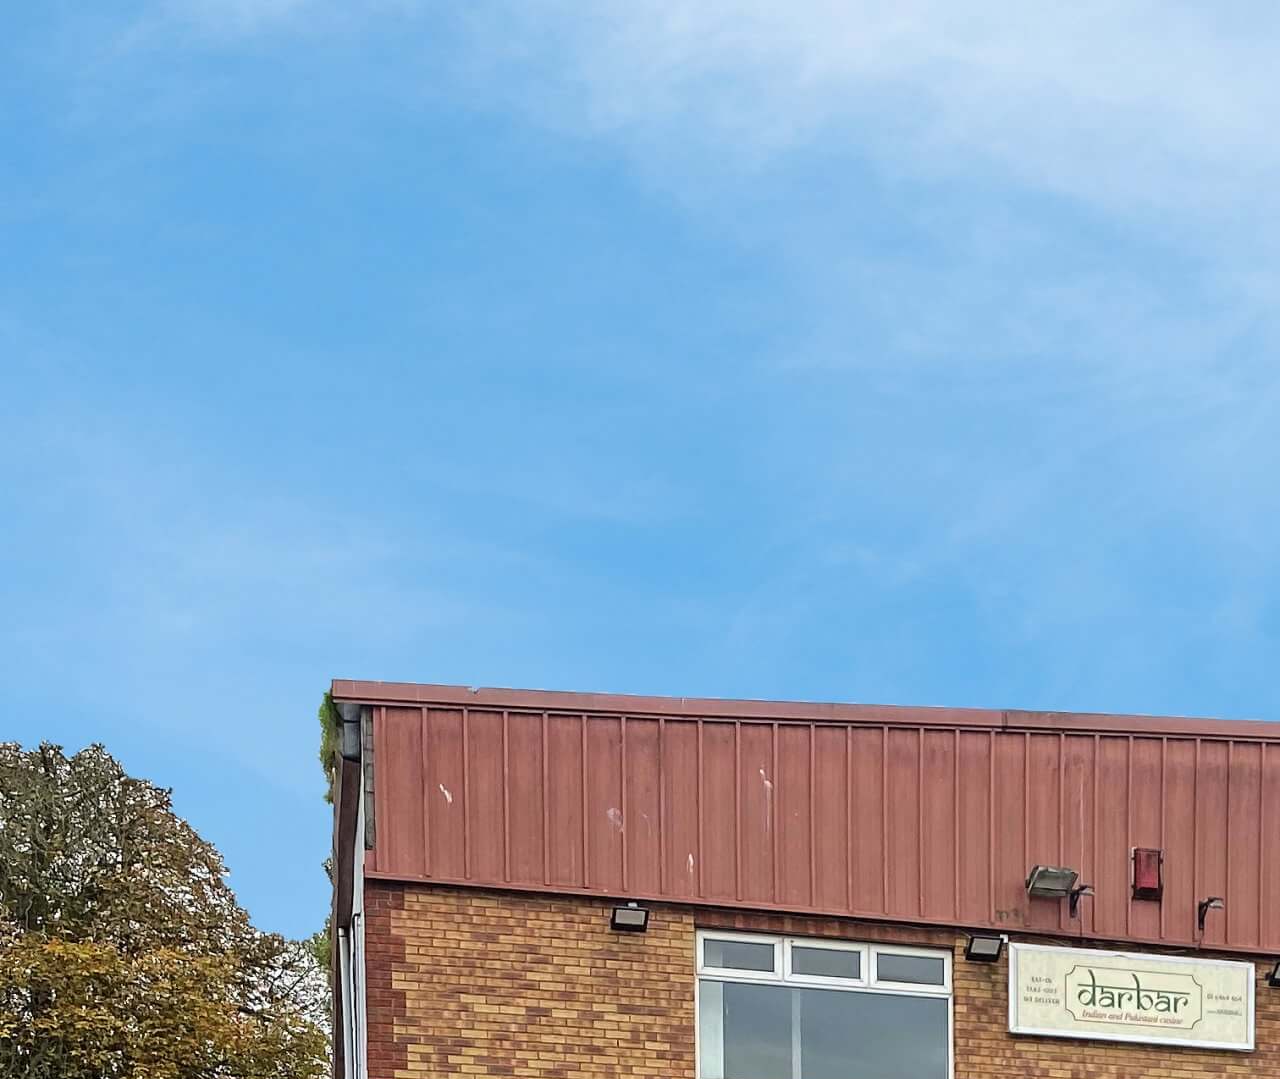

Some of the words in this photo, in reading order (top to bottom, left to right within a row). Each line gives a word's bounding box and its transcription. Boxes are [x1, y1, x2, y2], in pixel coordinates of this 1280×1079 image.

[1078, 969, 1190, 1013] darbar
[1082, 1009, 1107, 1018] Indian
[1108, 1011, 1123, 1019] and
